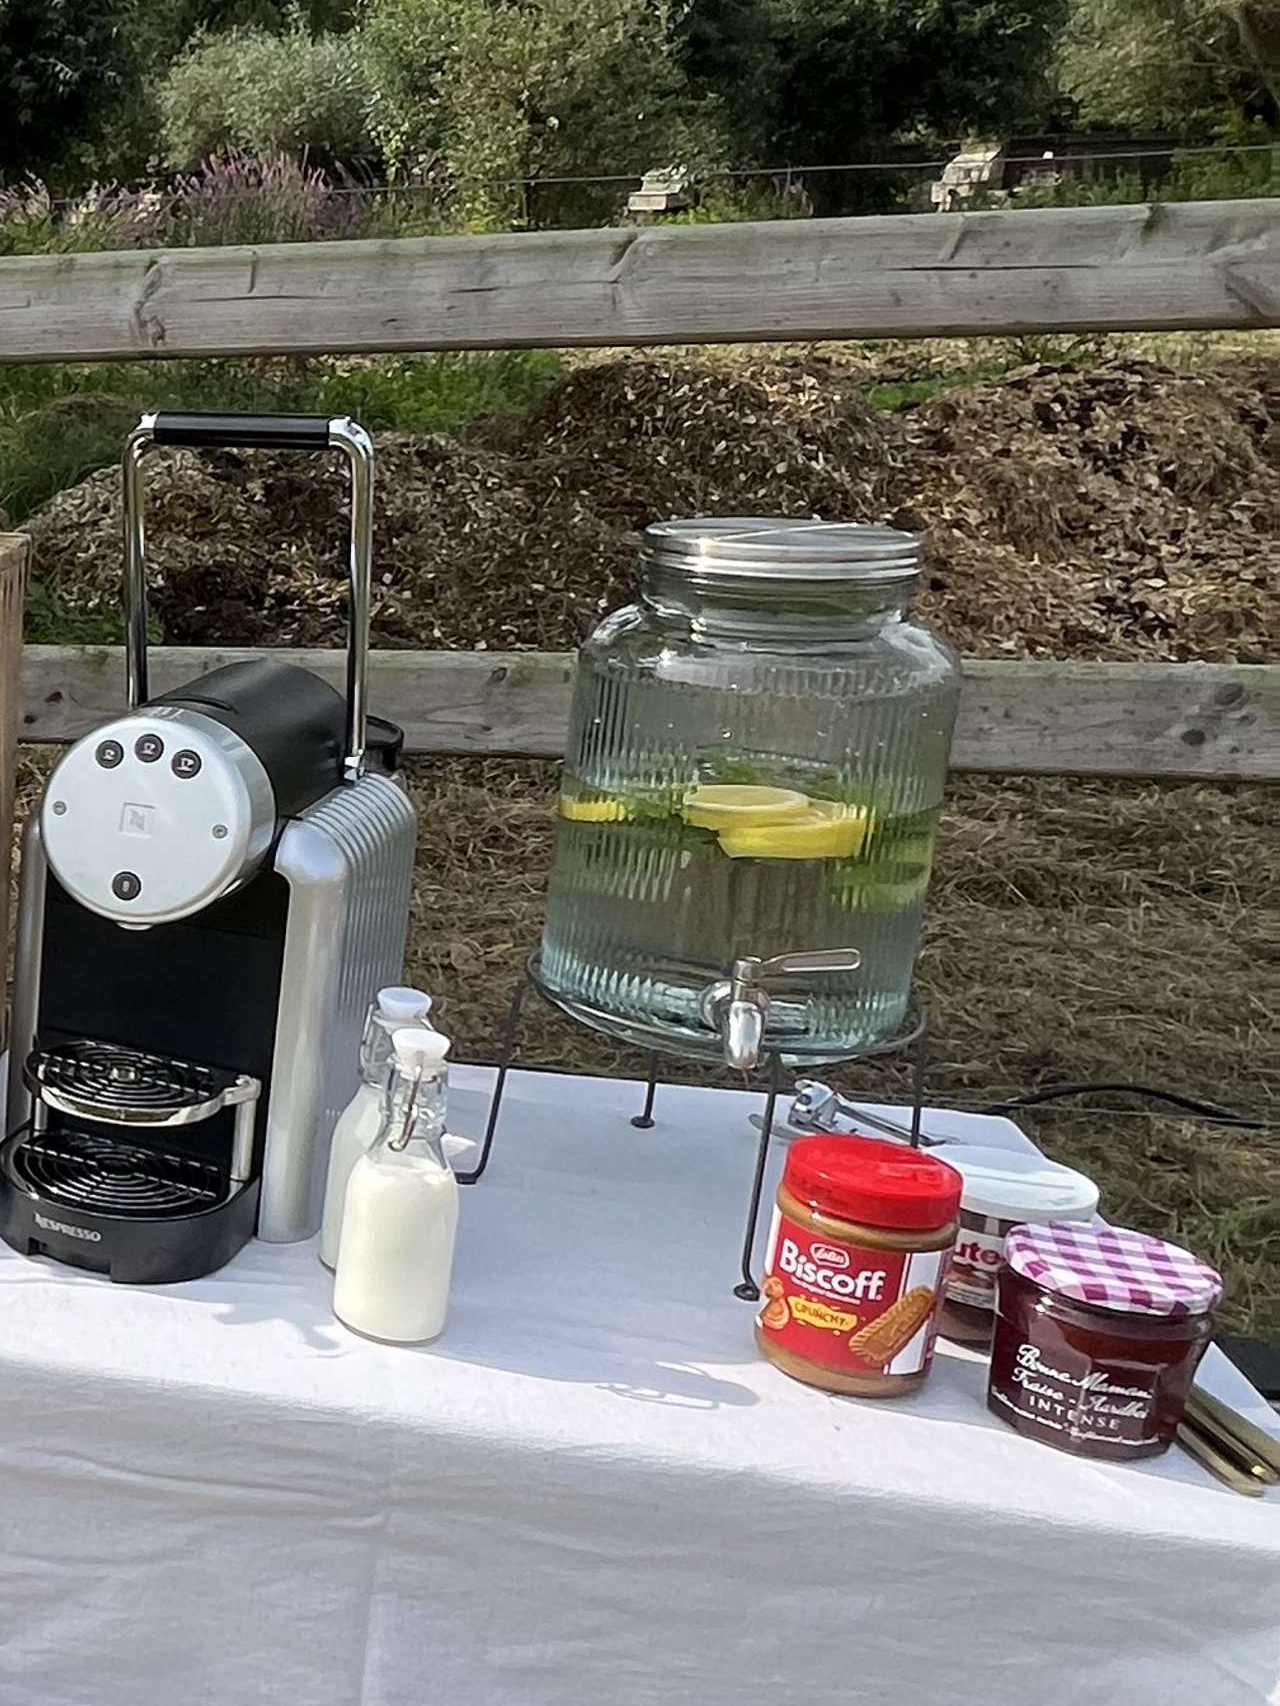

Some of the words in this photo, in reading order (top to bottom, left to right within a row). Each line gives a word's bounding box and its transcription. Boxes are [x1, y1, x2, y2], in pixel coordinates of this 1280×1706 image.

[779, 1237, 887, 1301] Biscoff
[794, 1301, 847, 1327] CRUNCHY
[1028, 1394, 1122, 1431] INTENSE
